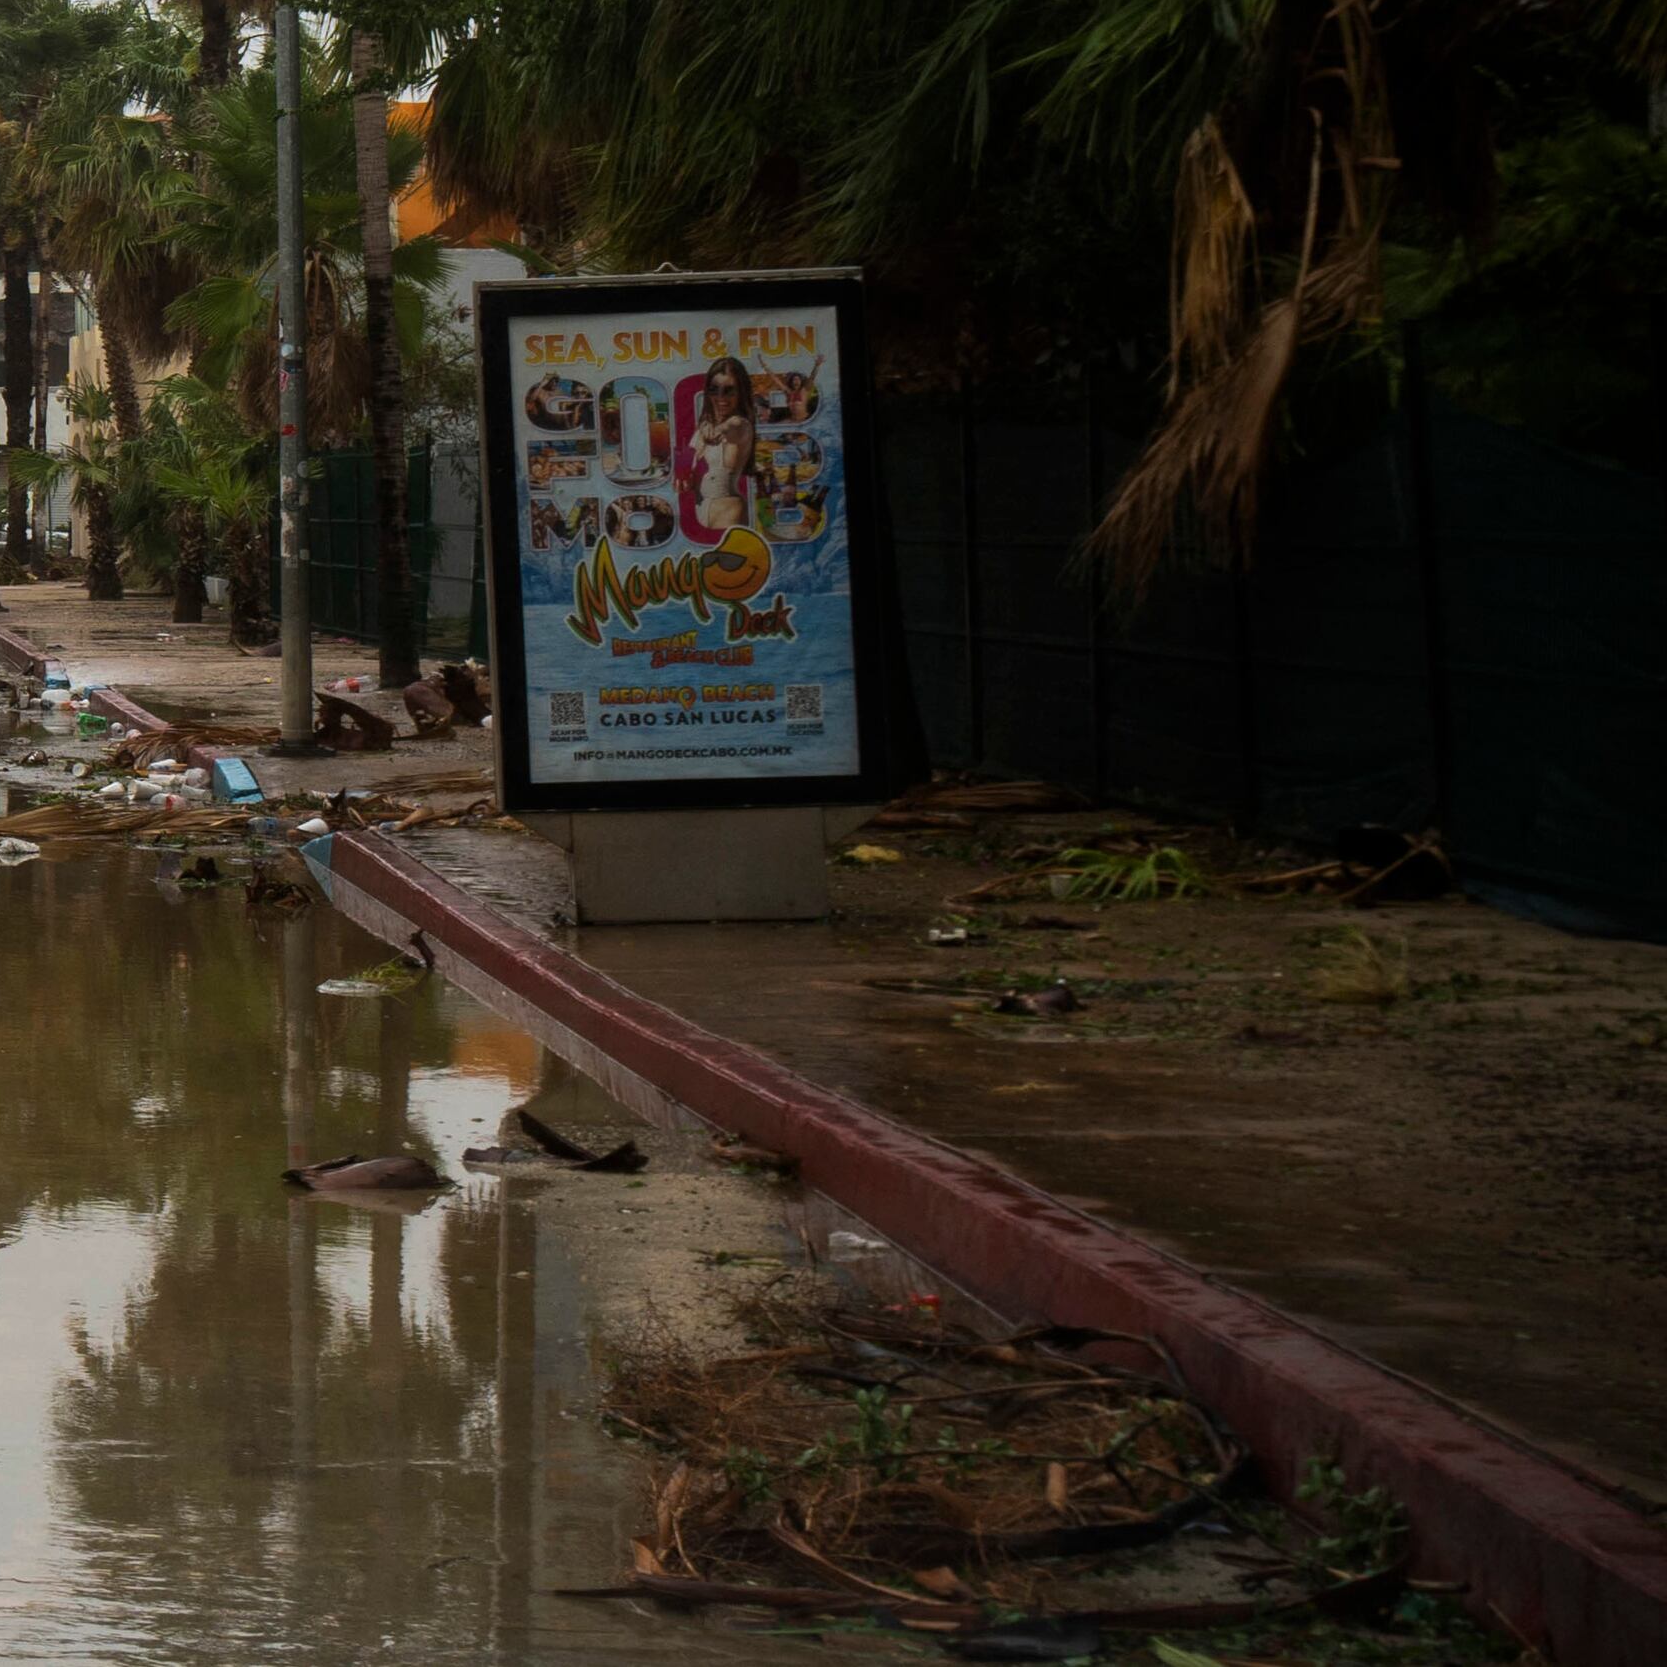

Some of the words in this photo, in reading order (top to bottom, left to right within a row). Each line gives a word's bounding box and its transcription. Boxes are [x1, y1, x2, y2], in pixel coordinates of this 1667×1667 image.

[524, 333, 606, 371] SEA,
[613, 329, 690, 364] SUN
[701, 328, 728, 359] &
[738, 325, 817, 357] FUN
[566, 527, 771, 647] Mango
[727, 593, 798, 642] Deck
[715, 644, 755, 667] CLUB
[702, 683, 775, 703] BEACH
[600, 713, 657, 727] CABO
[664, 711, 704, 725] SAN
[710, 709, 777, 724] LUCAS
